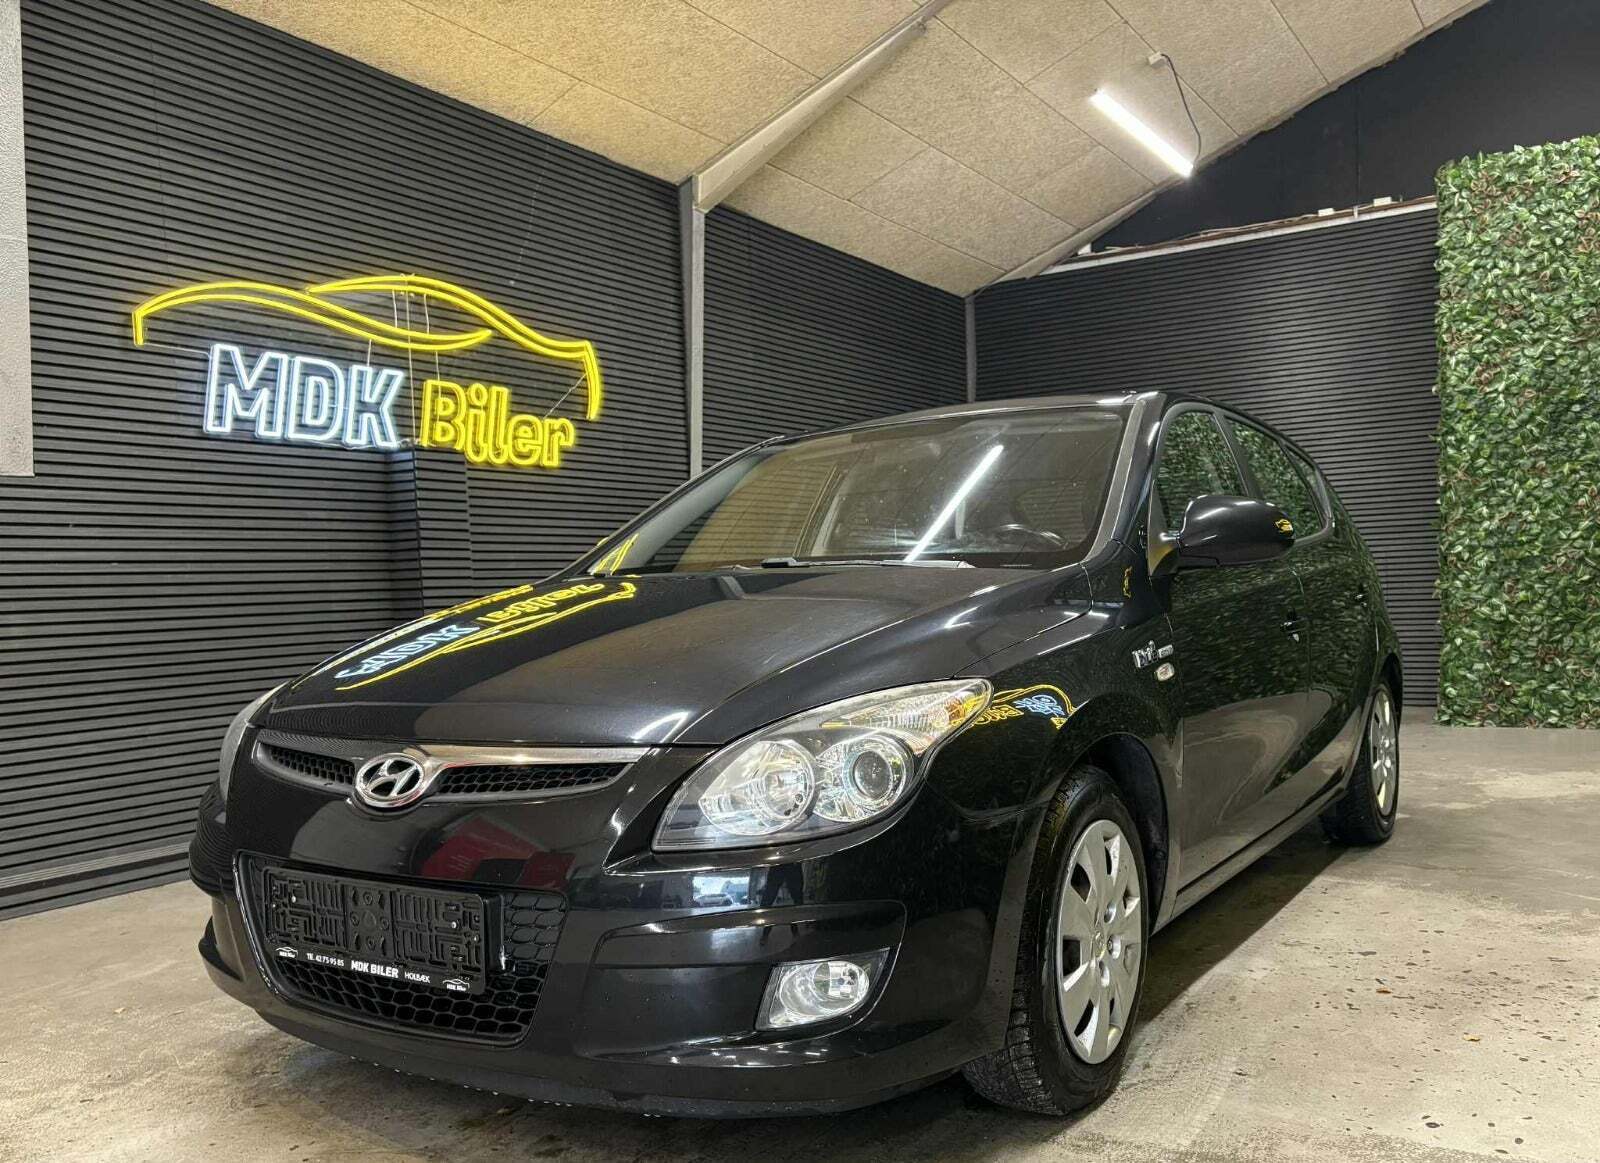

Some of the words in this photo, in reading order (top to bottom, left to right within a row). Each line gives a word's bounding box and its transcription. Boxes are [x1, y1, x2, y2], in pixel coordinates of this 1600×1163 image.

[204, 343, 403, 449] MDK
[420, 379, 576, 467] Biler
[351, 960, 369, 973] MDK
[370, 963, 399, 979] BILER
